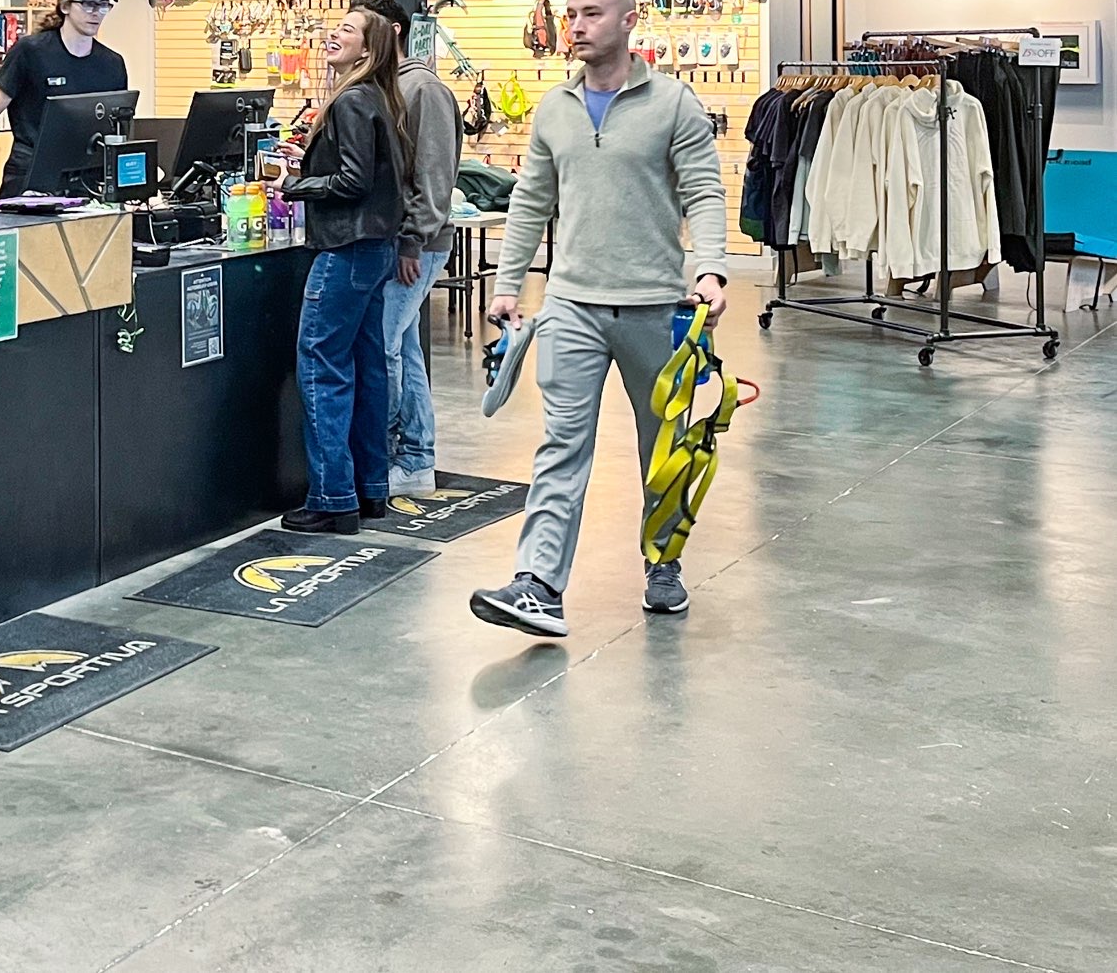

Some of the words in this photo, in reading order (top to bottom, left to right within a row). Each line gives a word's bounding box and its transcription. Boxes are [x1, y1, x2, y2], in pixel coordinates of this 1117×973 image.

[237, 218, 247, 232] G
[253, 217, 263, 231] G
[397, 518, 434, 531] LA
[425, 484, 523, 520] SPORTIVA
[256, 597, 298, 613] LA
[286, 547, 386, 597] SPORTIVA
[1, 640, 157, 708] SPORTIVA
